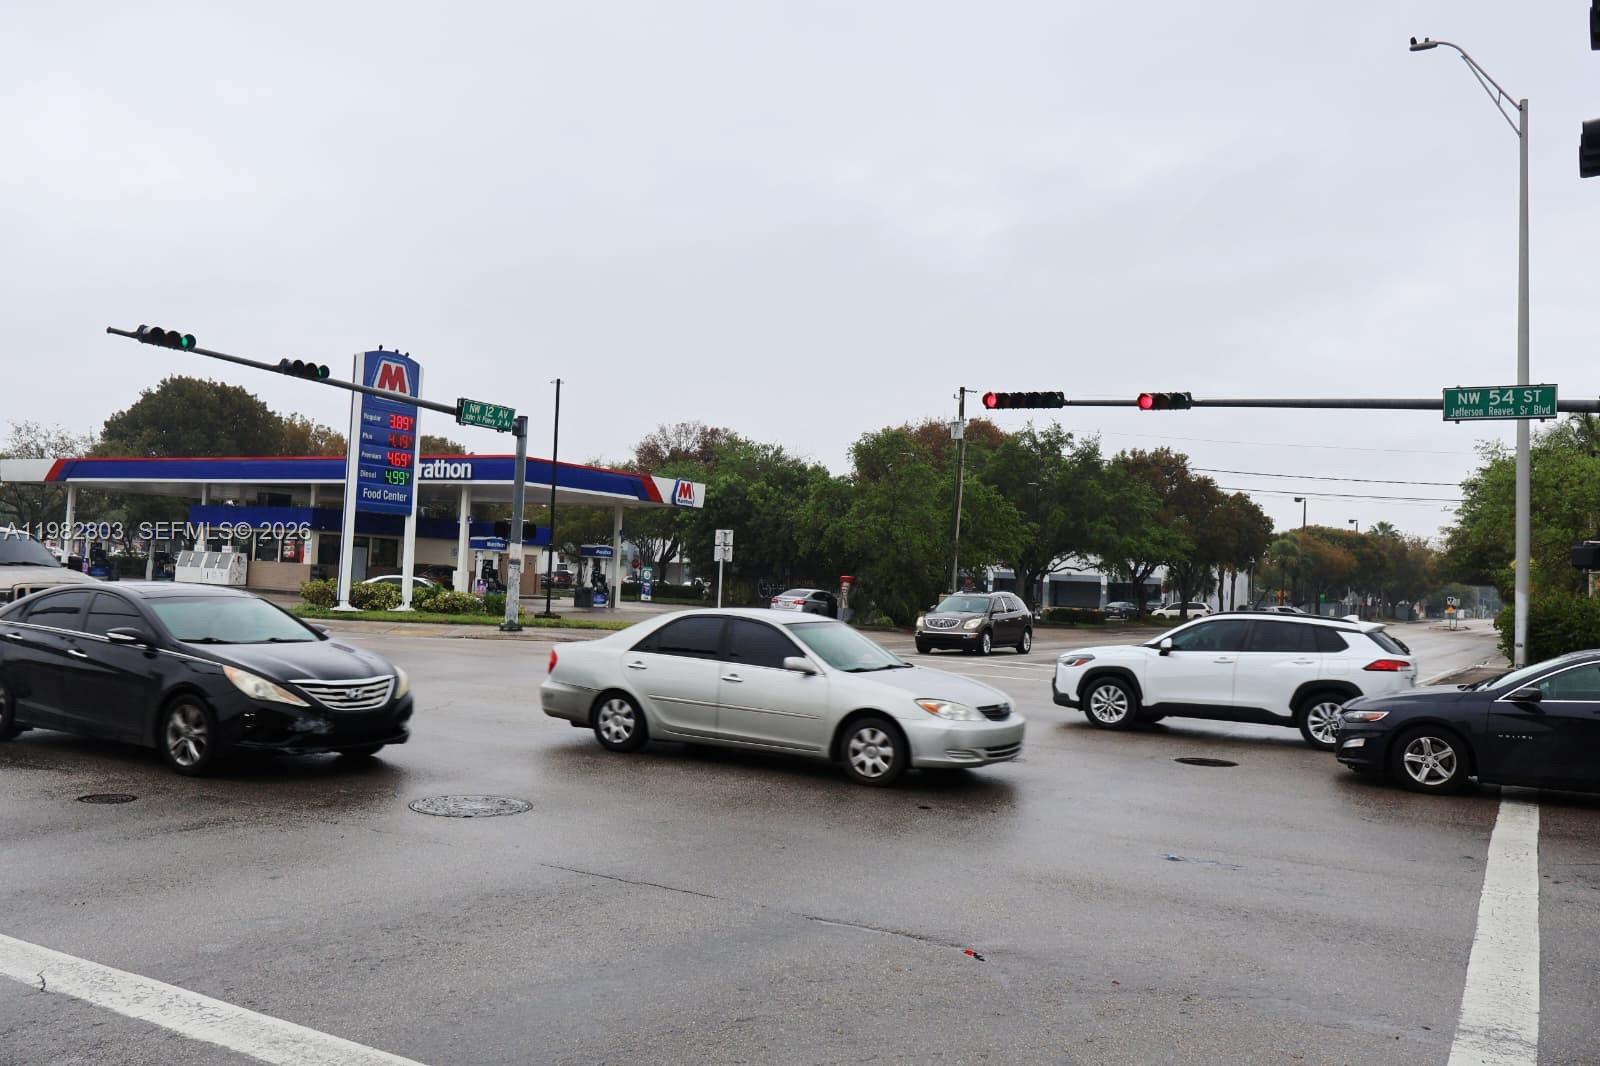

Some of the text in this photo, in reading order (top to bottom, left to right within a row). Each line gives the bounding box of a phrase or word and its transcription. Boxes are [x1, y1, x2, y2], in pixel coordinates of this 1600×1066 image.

[1458, 389, 1542, 406] NW 54 ST
[364, 412, 381, 422] Regular
[470, 403, 509, 419] NW 12 AV
[1450, 404, 1551, 417] Jefferson Reaves Sr Blvd
[361, 451, 382, 460] Premium
[360, 470, 377, 479] Diesel
[418, 460, 472, 479] rathon
[363, 487, 408, 502] Food Center
